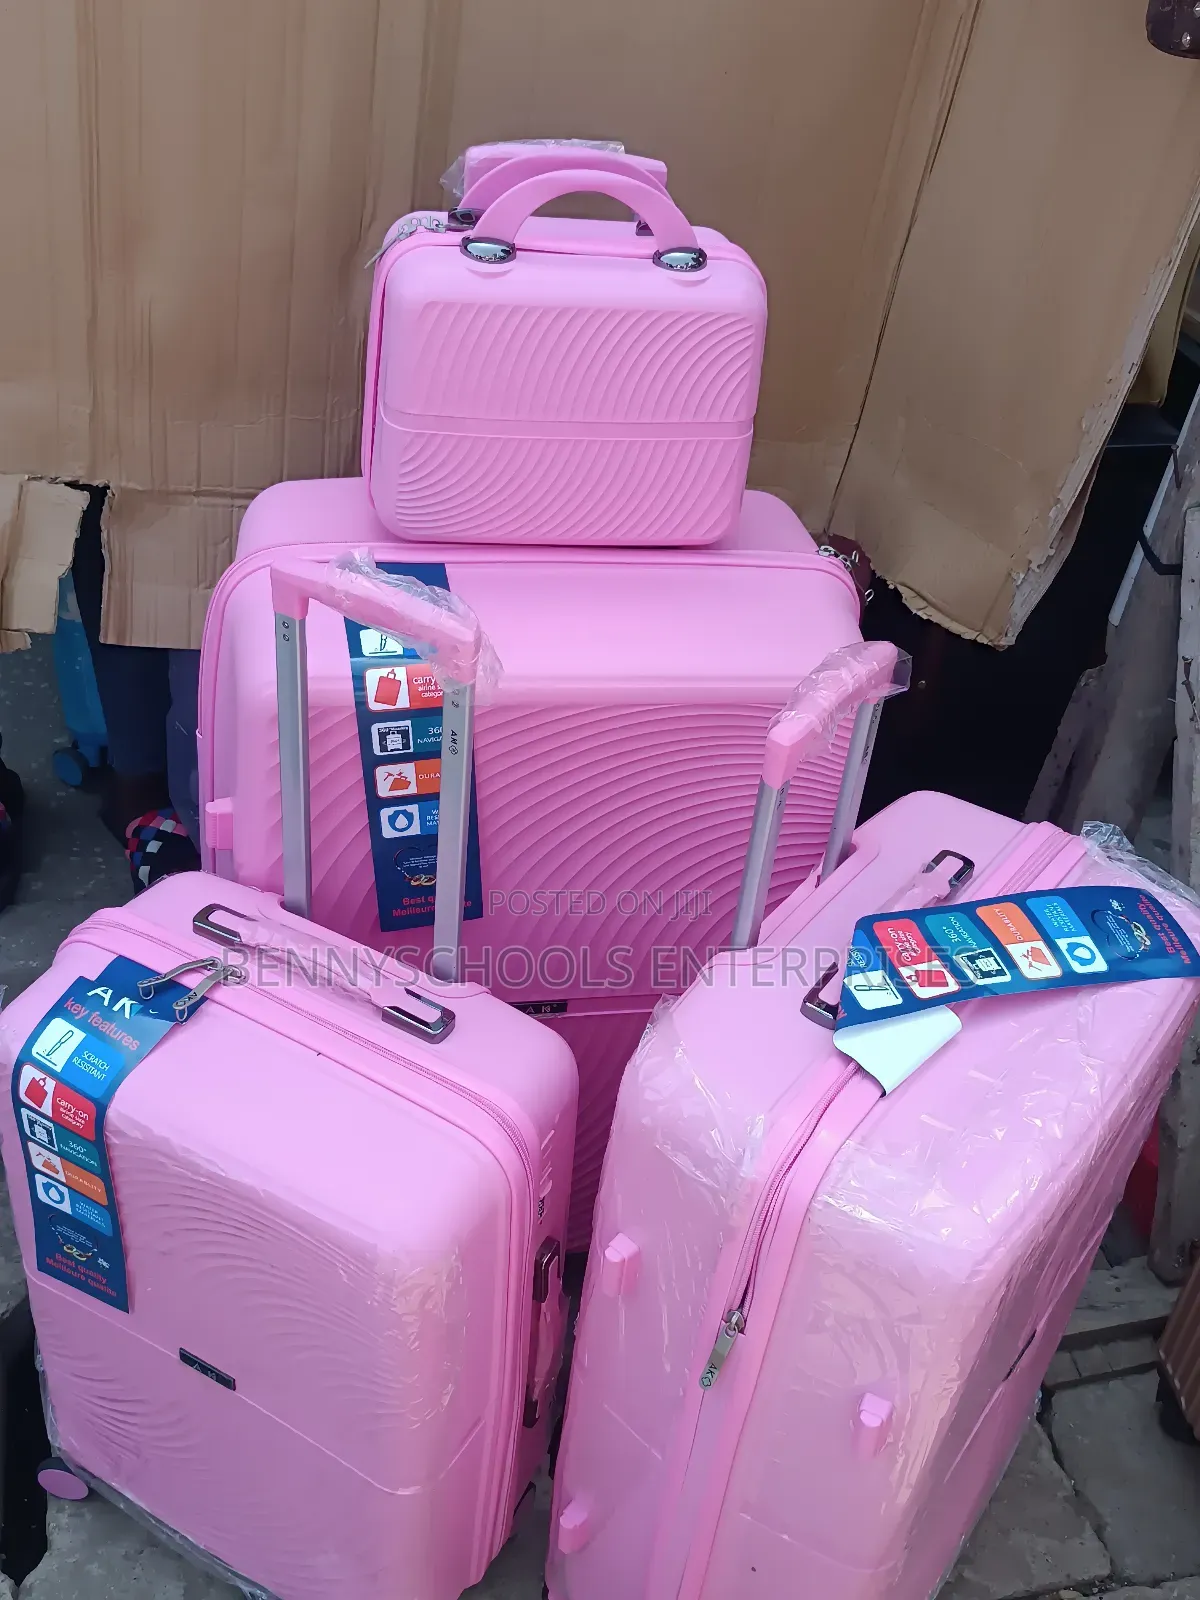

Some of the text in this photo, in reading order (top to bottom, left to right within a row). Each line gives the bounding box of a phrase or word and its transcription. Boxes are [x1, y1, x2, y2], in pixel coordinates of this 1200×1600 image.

[412, 676, 436, 686] carry
[392, 905, 436, 917] Meilleur
[402, 895, 426, 906] Best
[1157, 932, 1178, 955] Best
[64, 996, 141, 1052] key features
[81, 1050, 111, 1072] SCRATCH
[56, 1097, 89, 1121] carry-on
